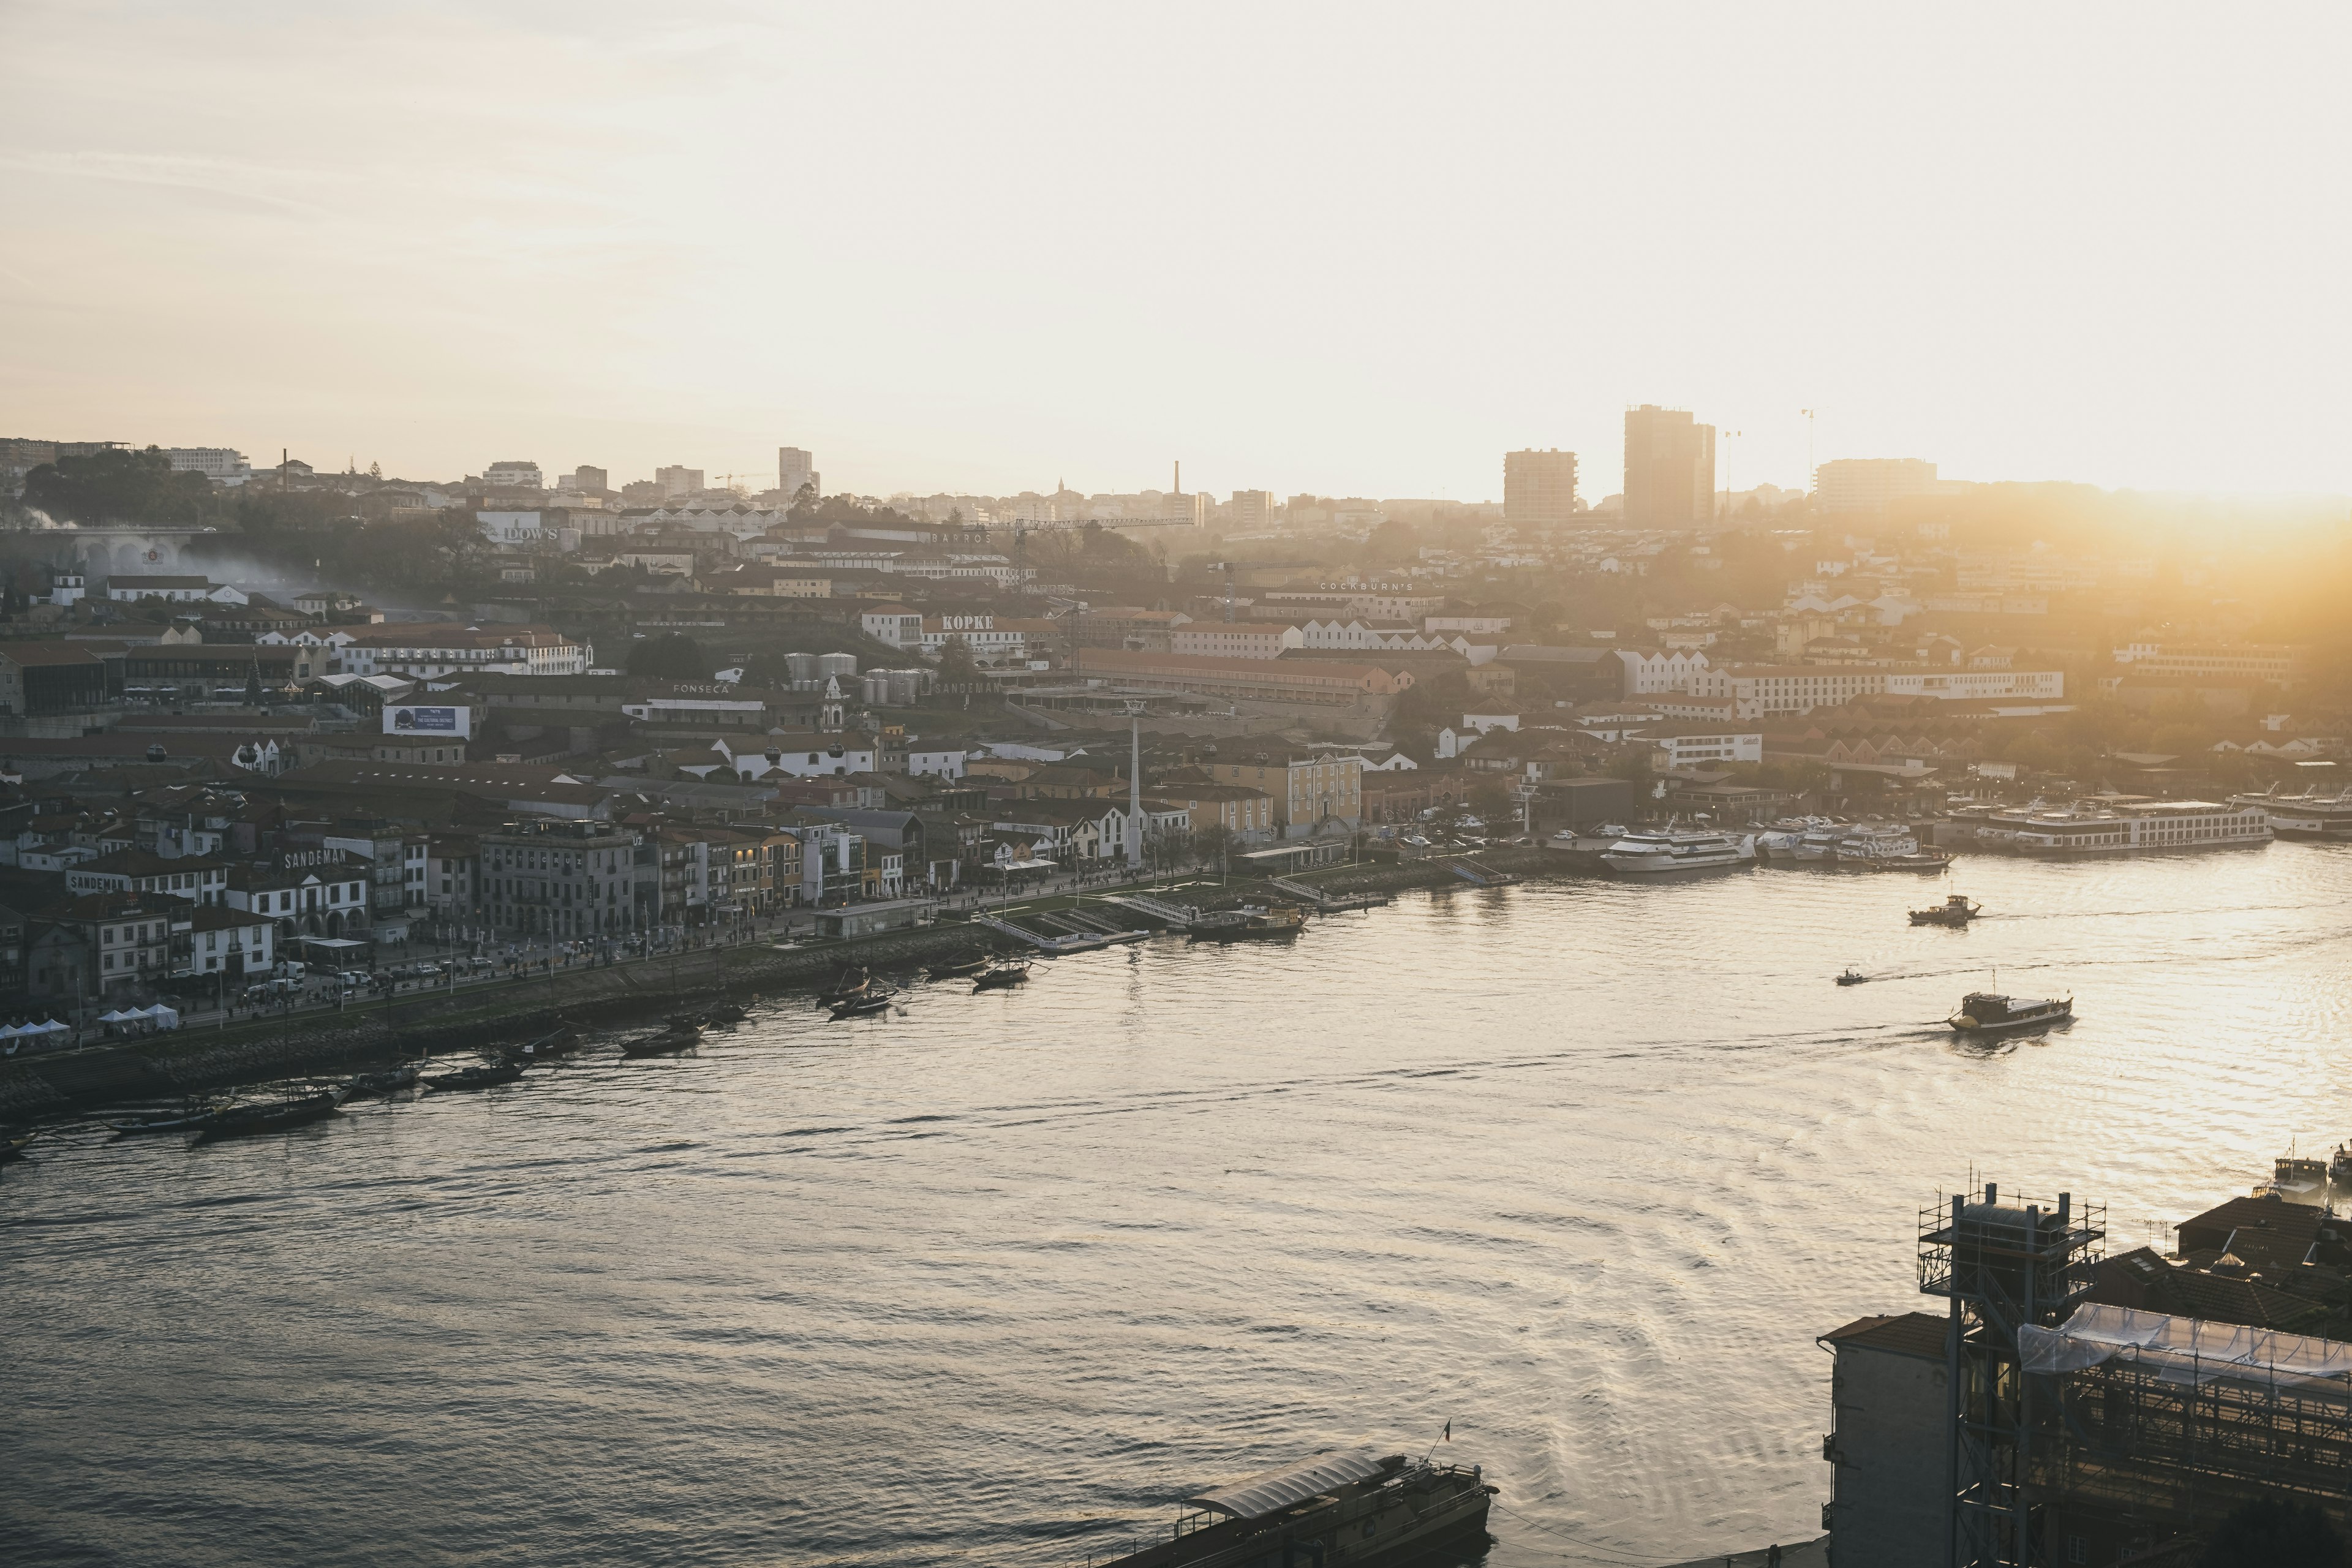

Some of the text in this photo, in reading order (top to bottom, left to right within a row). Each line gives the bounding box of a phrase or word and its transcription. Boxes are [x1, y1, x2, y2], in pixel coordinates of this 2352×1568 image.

[507, 528, 557, 540] DOW'S
[932, 534, 991, 544] BARROS
[942, 616, 993, 630] KOPKE
[1967, 661, 2013, 671] FERREIRA
[673, 684, 729, 694] FONSECA
[935, 682, 1000, 694] SANDEMAN
[284, 847, 346, 869] SANDEMAN
[70, 876, 124, 891] SANDEMAN
